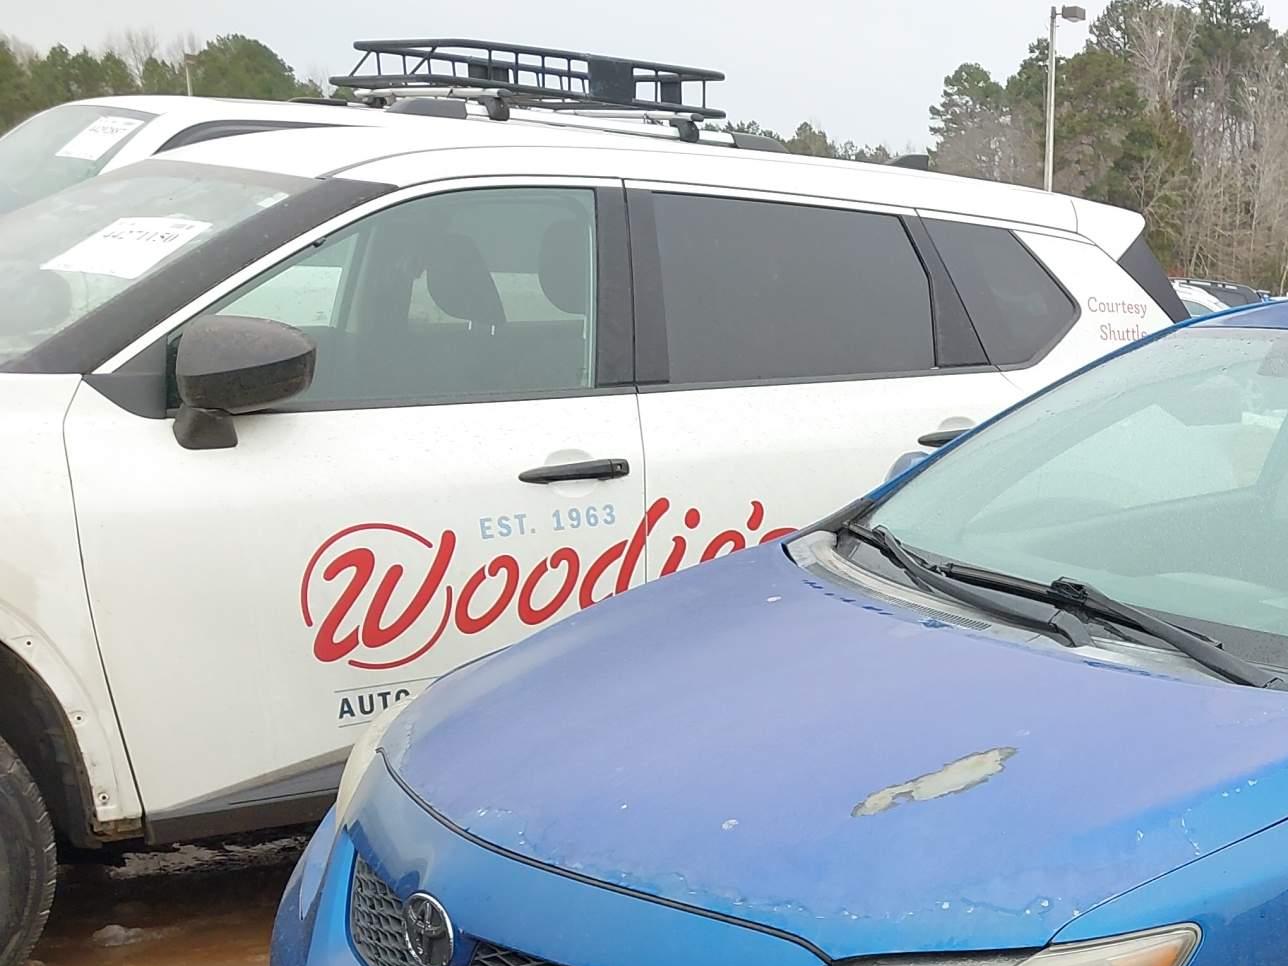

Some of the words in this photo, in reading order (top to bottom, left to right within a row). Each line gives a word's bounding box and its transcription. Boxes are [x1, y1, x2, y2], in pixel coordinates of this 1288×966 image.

[1087, 296, 1148, 319] Courtesy
[479, 513, 536, 540] EST.
[552, 504, 616, 531] 1963
